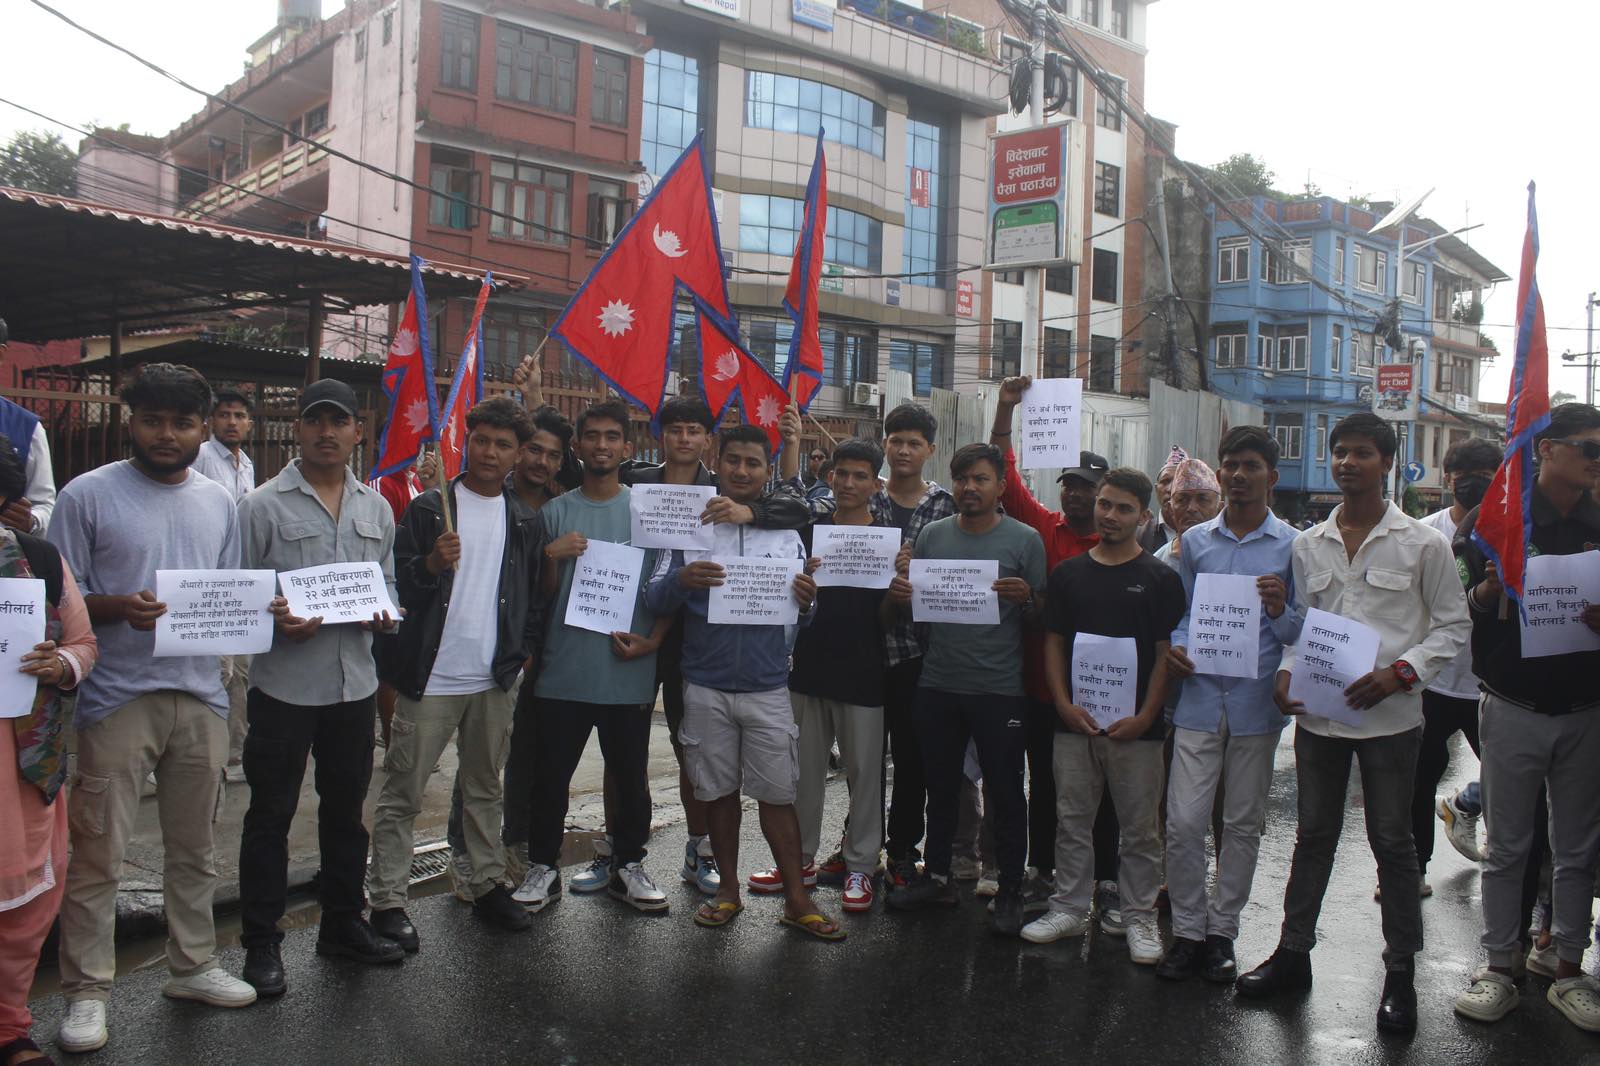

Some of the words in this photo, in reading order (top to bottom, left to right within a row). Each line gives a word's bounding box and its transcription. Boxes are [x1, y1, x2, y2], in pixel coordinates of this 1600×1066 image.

[1006, 145, 1049, 163] विदेशबाट
[1008, 162, 1046, 180] इसेवामा
[996, 183, 1017, 196] पैसा
[1020, 176, 1057, 192] पठाउँदा
[318, 568, 374, 584] प्राधिकरणको
[210, 579, 235, 588] उज्यालो
[608, 584, 624, 592] रकम
[305, 591, 317, 600] २२
[1528, 585, 1578, 596] माफियाको
[578, 592, 596, 602] असुल
[333, 600, 357, 612] असुल
[359, 597, 378, 605] उपर
[1200, 604, 1209, 612] २२
[208, 609, 225, 618] रहेको
[1227, 621, 1245, 629] रकम
[1529, 614, 1566, 626] चोरलाई
[170, 623, 196, 633] कुलमान
[181, 631, 198, 639] करोड
[1197, 633, 1215, 643] असुल
[1307, 640, 1335, 654] सरकार
[1080, 662, 1088, 670] २२
[1079, 688, 1095, 698] असुल
